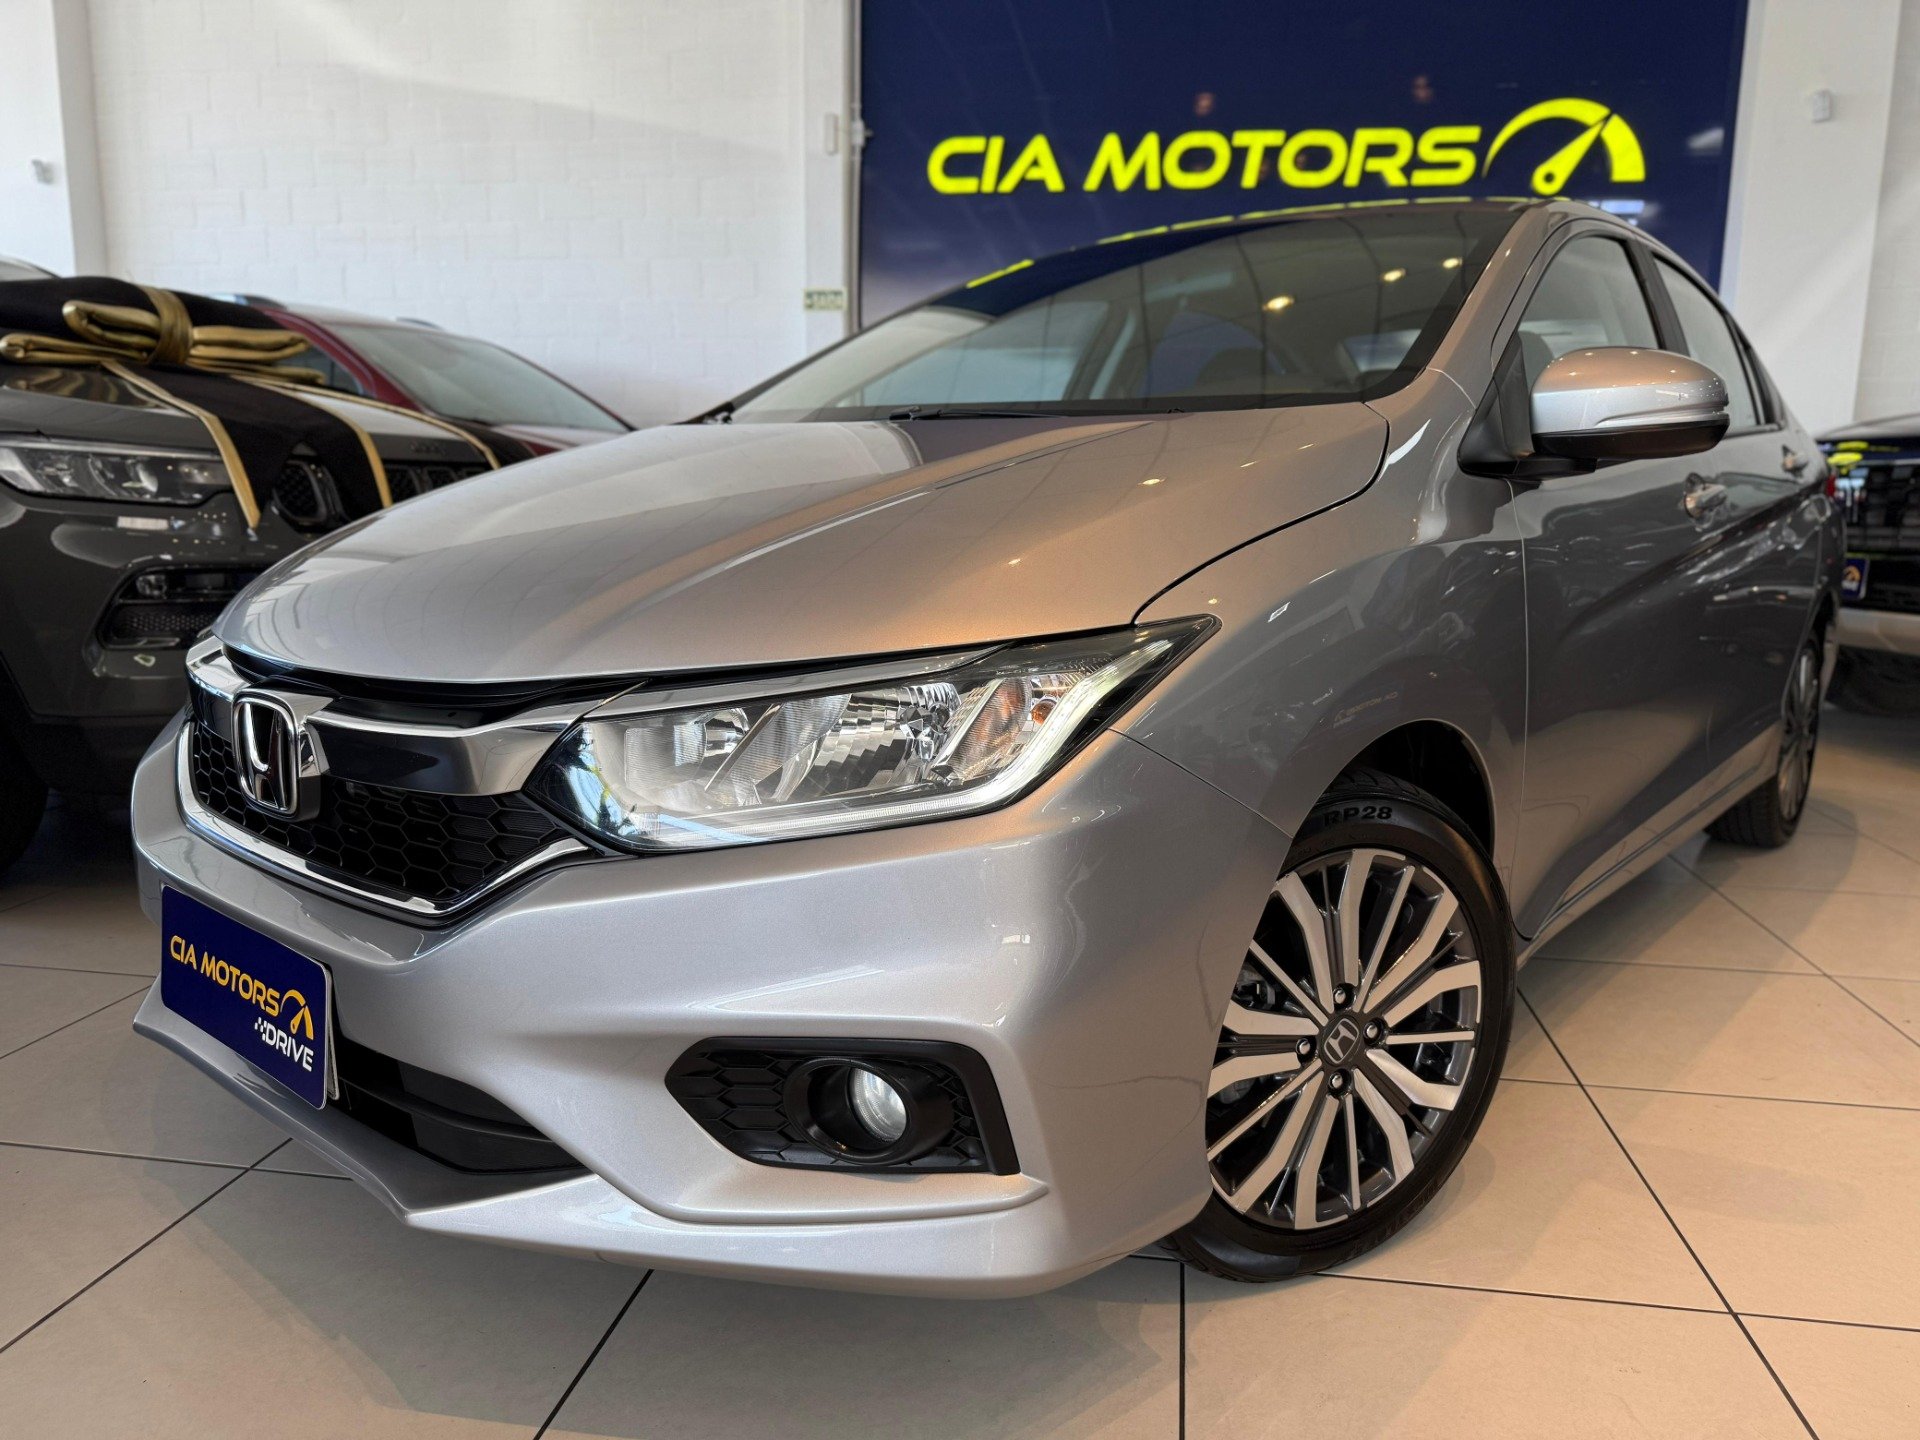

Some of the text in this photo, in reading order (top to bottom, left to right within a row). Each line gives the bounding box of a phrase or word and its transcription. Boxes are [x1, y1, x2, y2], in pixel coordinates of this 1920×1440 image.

[926, 125, 1482, 194] CIA MOTORS
[1323, 805, 1393, 827] RP28
[169, 935, 281, 1017] CIA MOTORS
[263, 1021, 314, 1072] DRIVE
